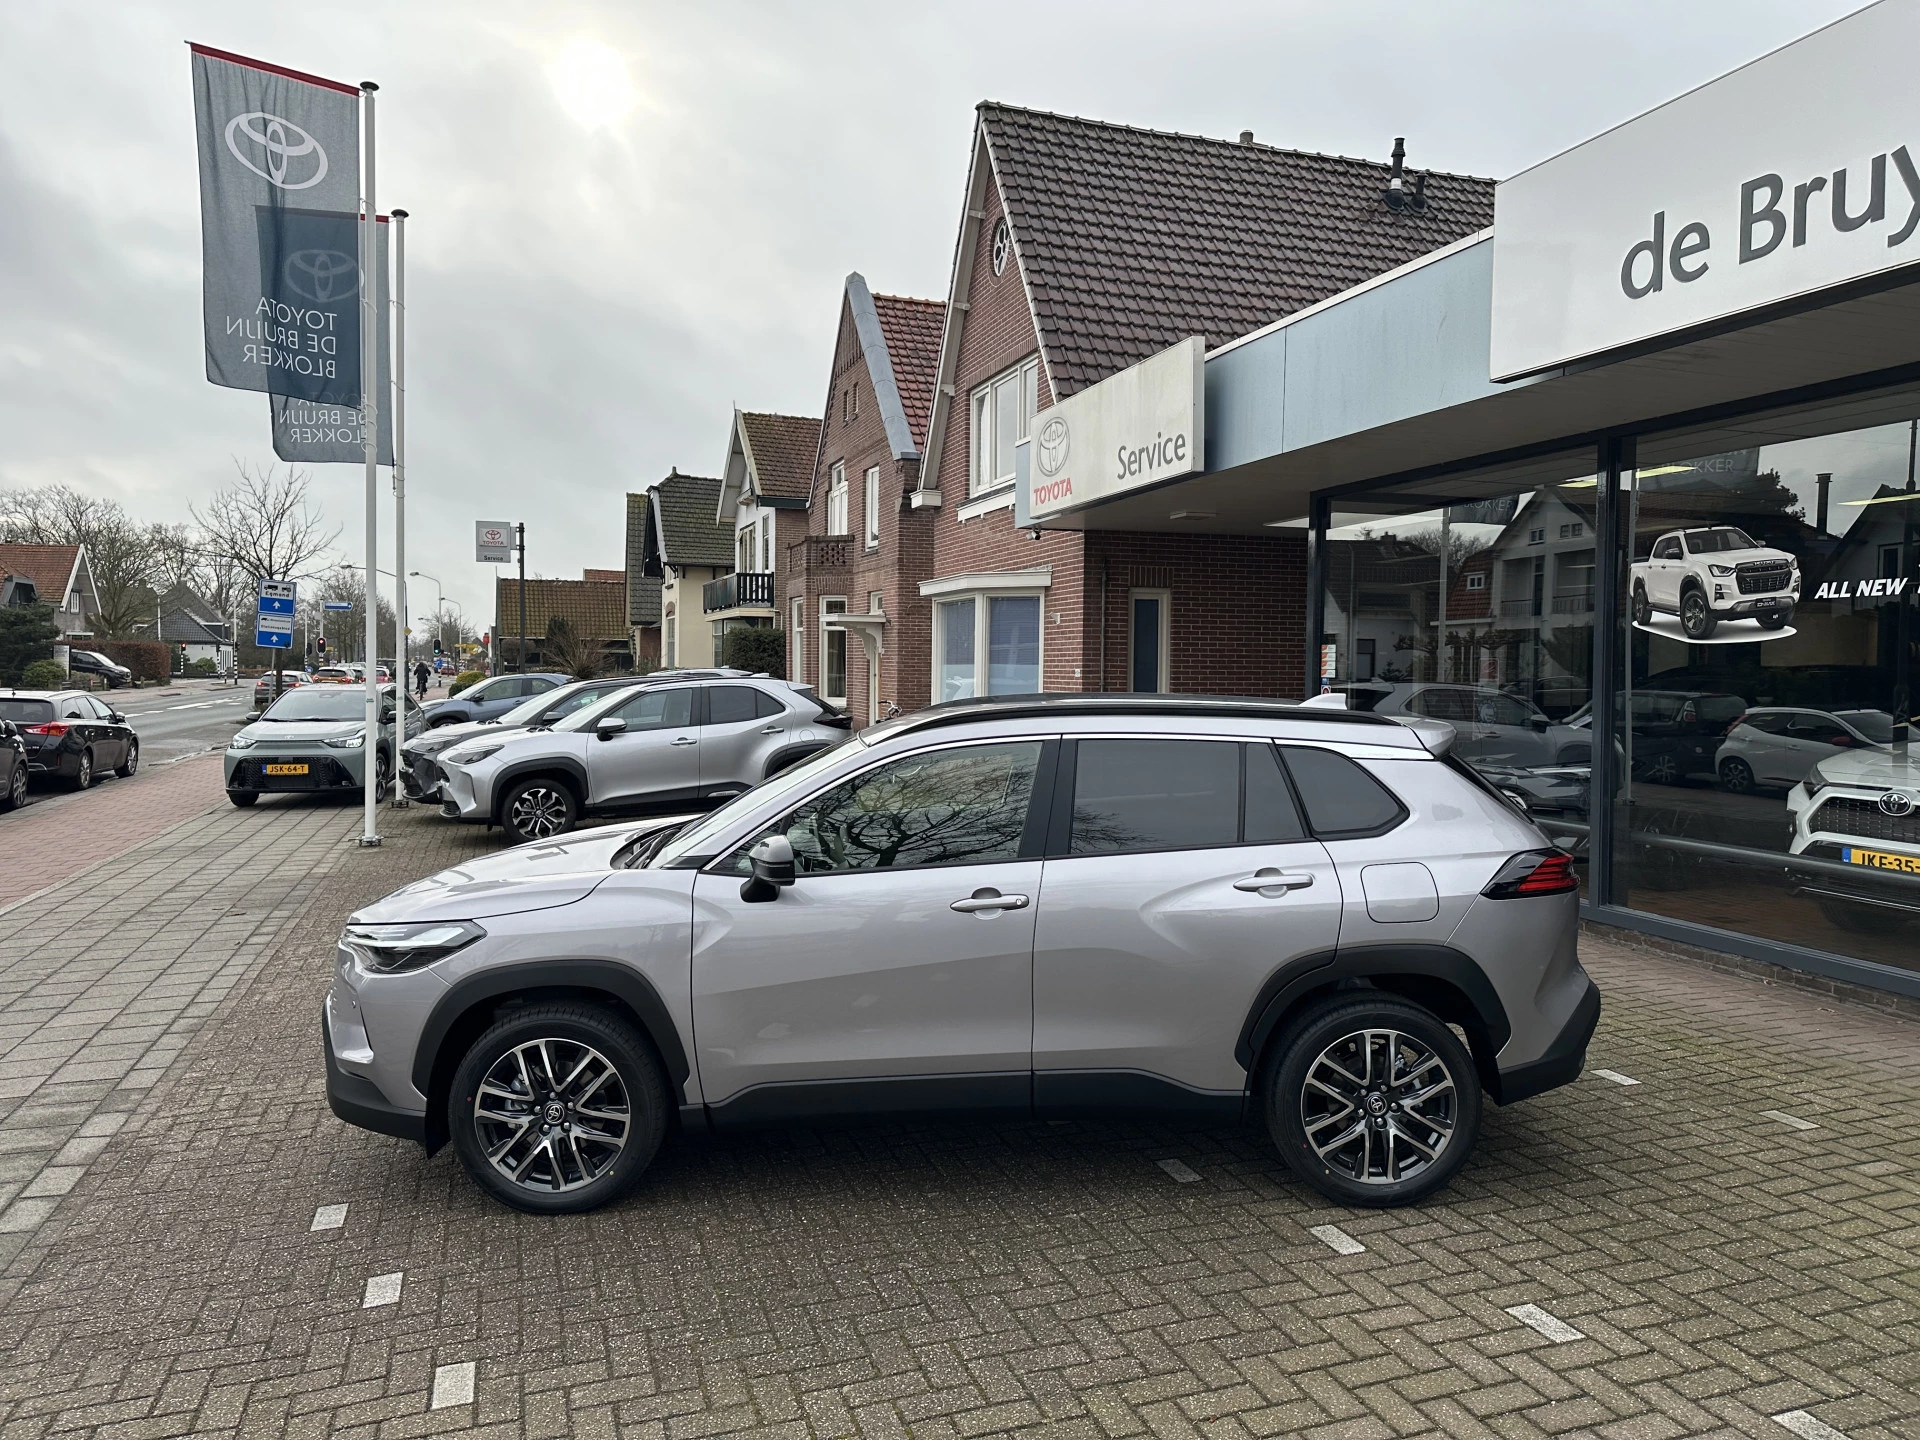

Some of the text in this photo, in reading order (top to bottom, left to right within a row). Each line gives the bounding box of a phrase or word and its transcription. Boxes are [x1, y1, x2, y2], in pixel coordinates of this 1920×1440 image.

[1621, 210, 1710, 299] de
[1117, 431, 1186, 480] Service
[1033, 477, 1073, 506] TOYOTA
[1814, 581, 1852, 599] ALL
[1855, 577, 1909, 597] NEW
[269, 765, 305, 773] JSK-64-T
